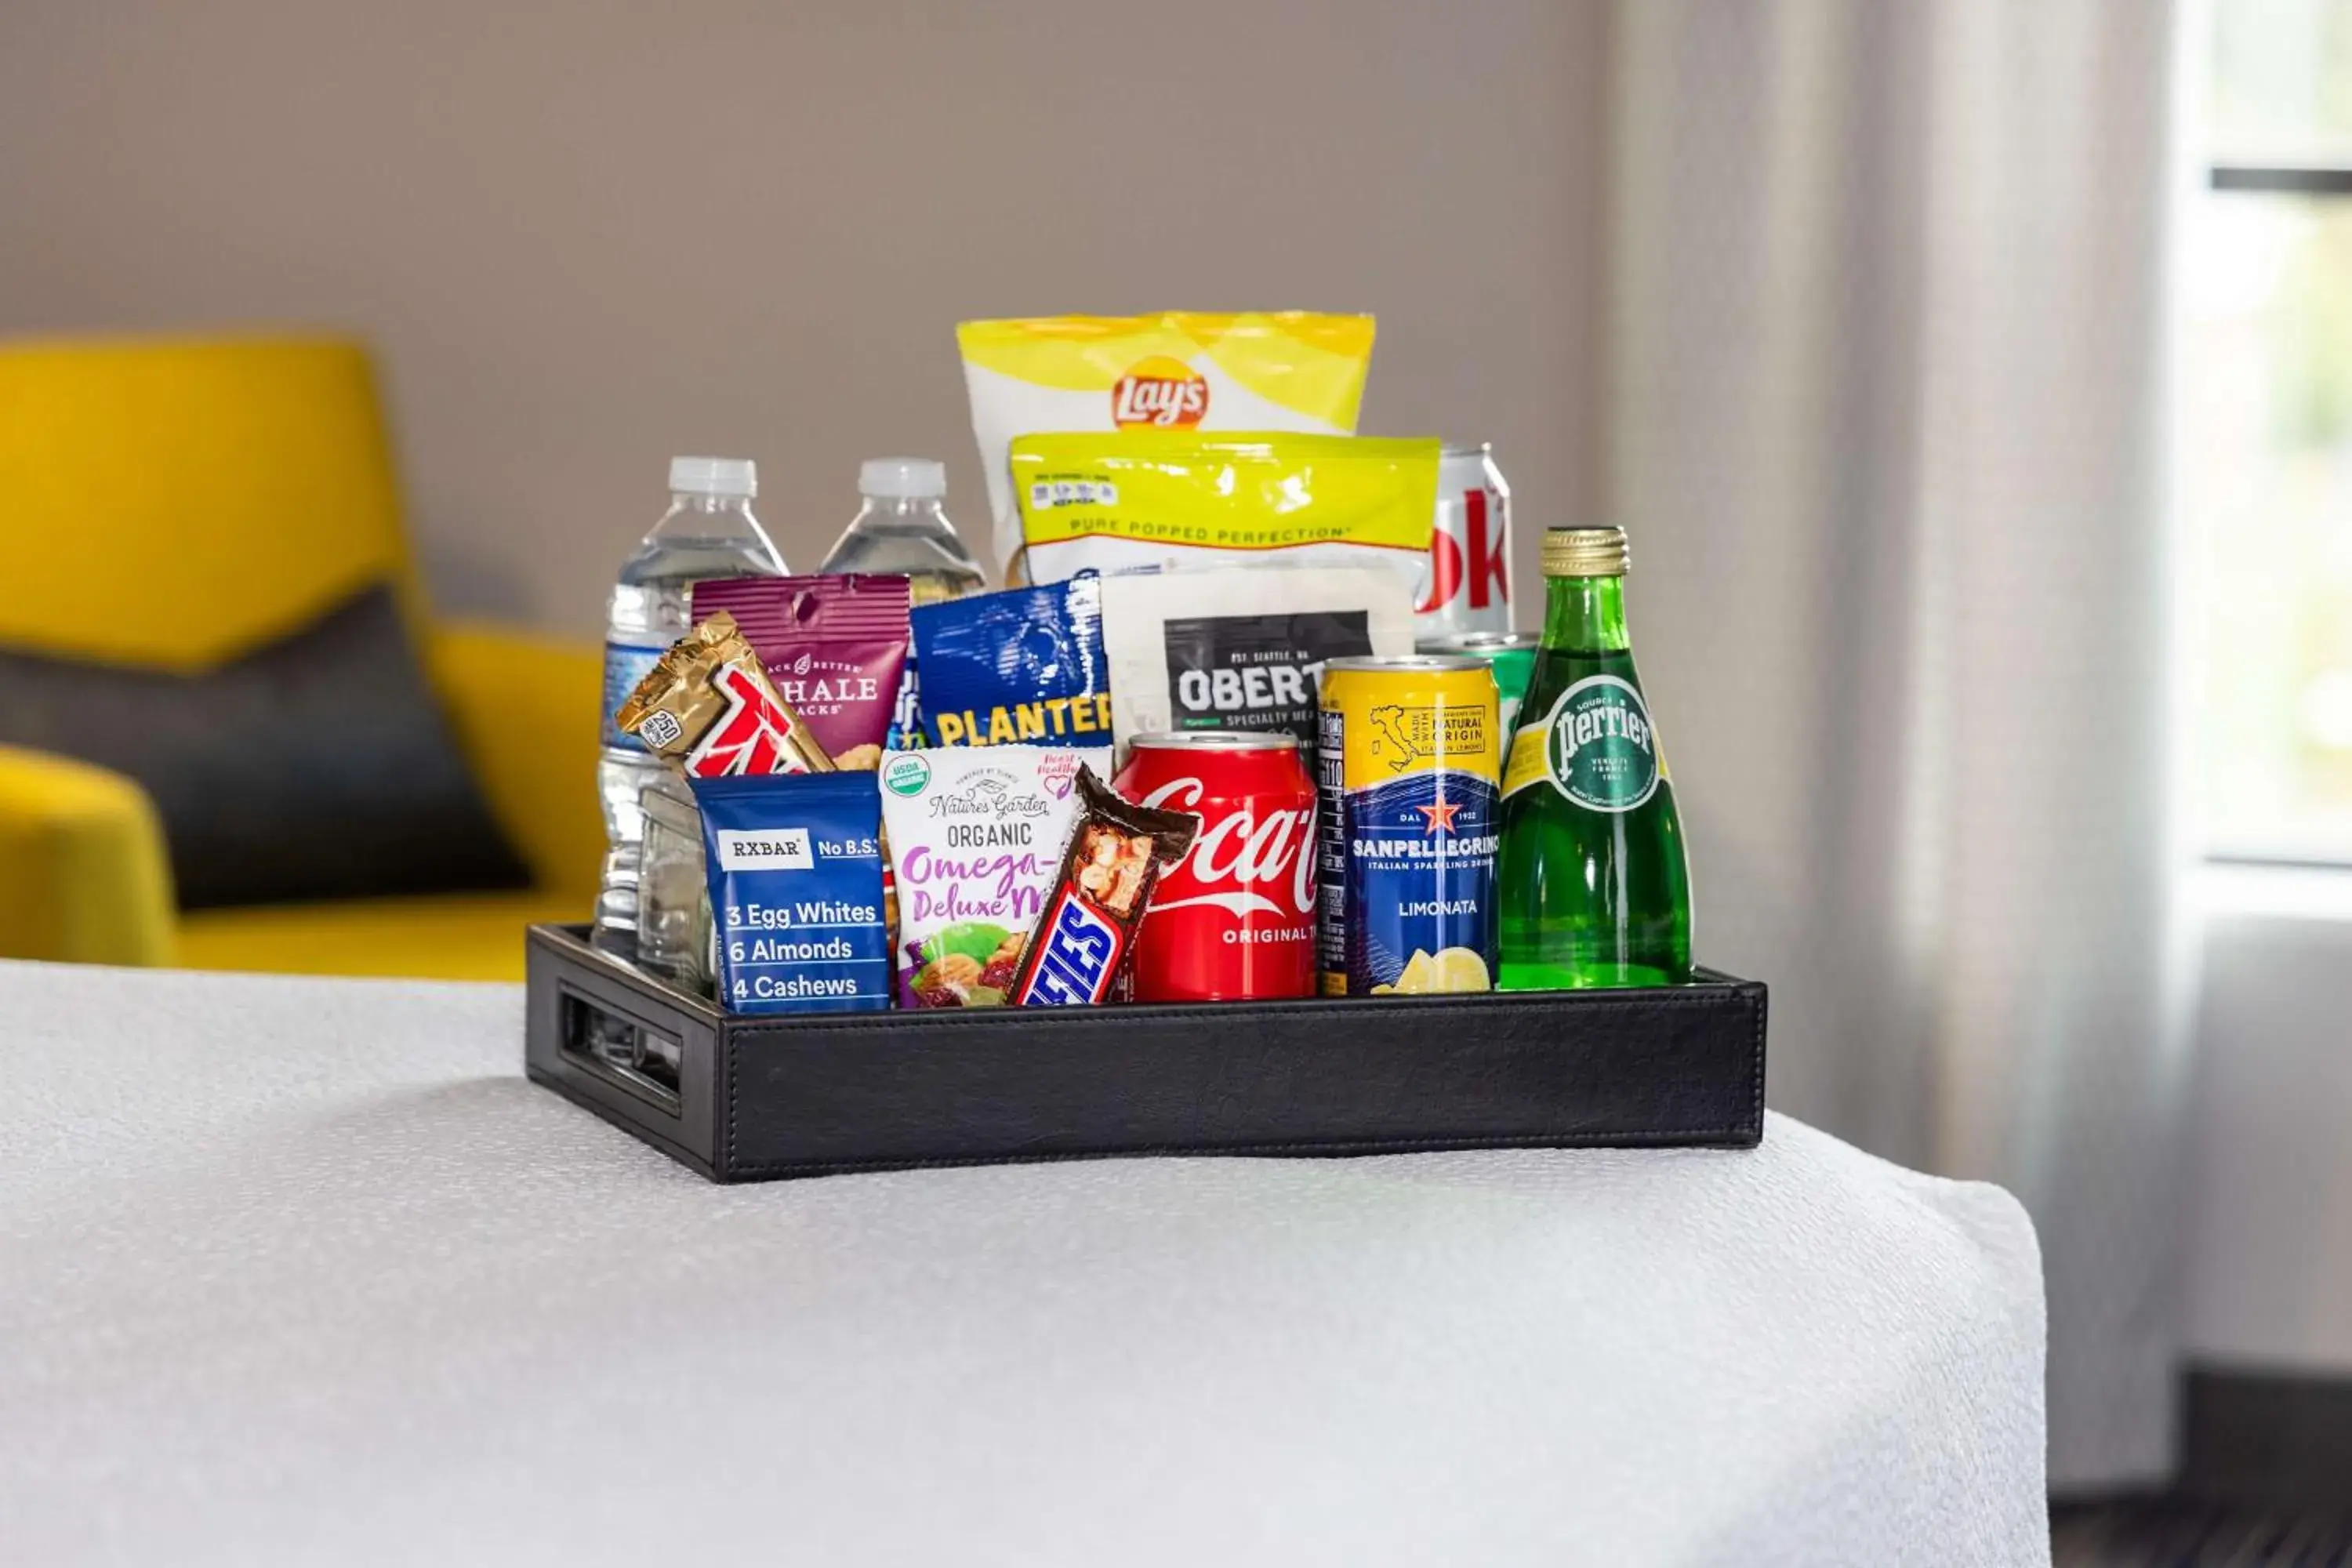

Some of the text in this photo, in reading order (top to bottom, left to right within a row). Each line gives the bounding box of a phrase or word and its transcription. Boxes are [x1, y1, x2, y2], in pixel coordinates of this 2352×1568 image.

[1117, 376, 1205, 426] Lay's
[1069, 517, 1344, 543] PURE POPPED PERFECTION
[652, 713, 678, 739] 250
[893, 761, 920, 775] USDA
[991, 793, 1050, 821] Garden
[1399, 814, 1421, 822] DAL
[818, 840, 842, 855] No
[947, 823, 1033, 848] ORGANIC
[1352, 834, 1500, 858] SANPELLEGRINO
[732, 841, 800, 857] RXBAR
[1368, 862, 1409, 870] ITALIAN
[726, 900, 877, 929] 3 Egg Whites
[913, 883, 1008, 922] Deluxe
[1399, 900, 1478, 916] LIMONATA
[1222, 927, 1307, 944] ORIGINAL
[730, 936, 853, 962] 6 Almonds
[733, 974, 858, 998] 4 Cashews
